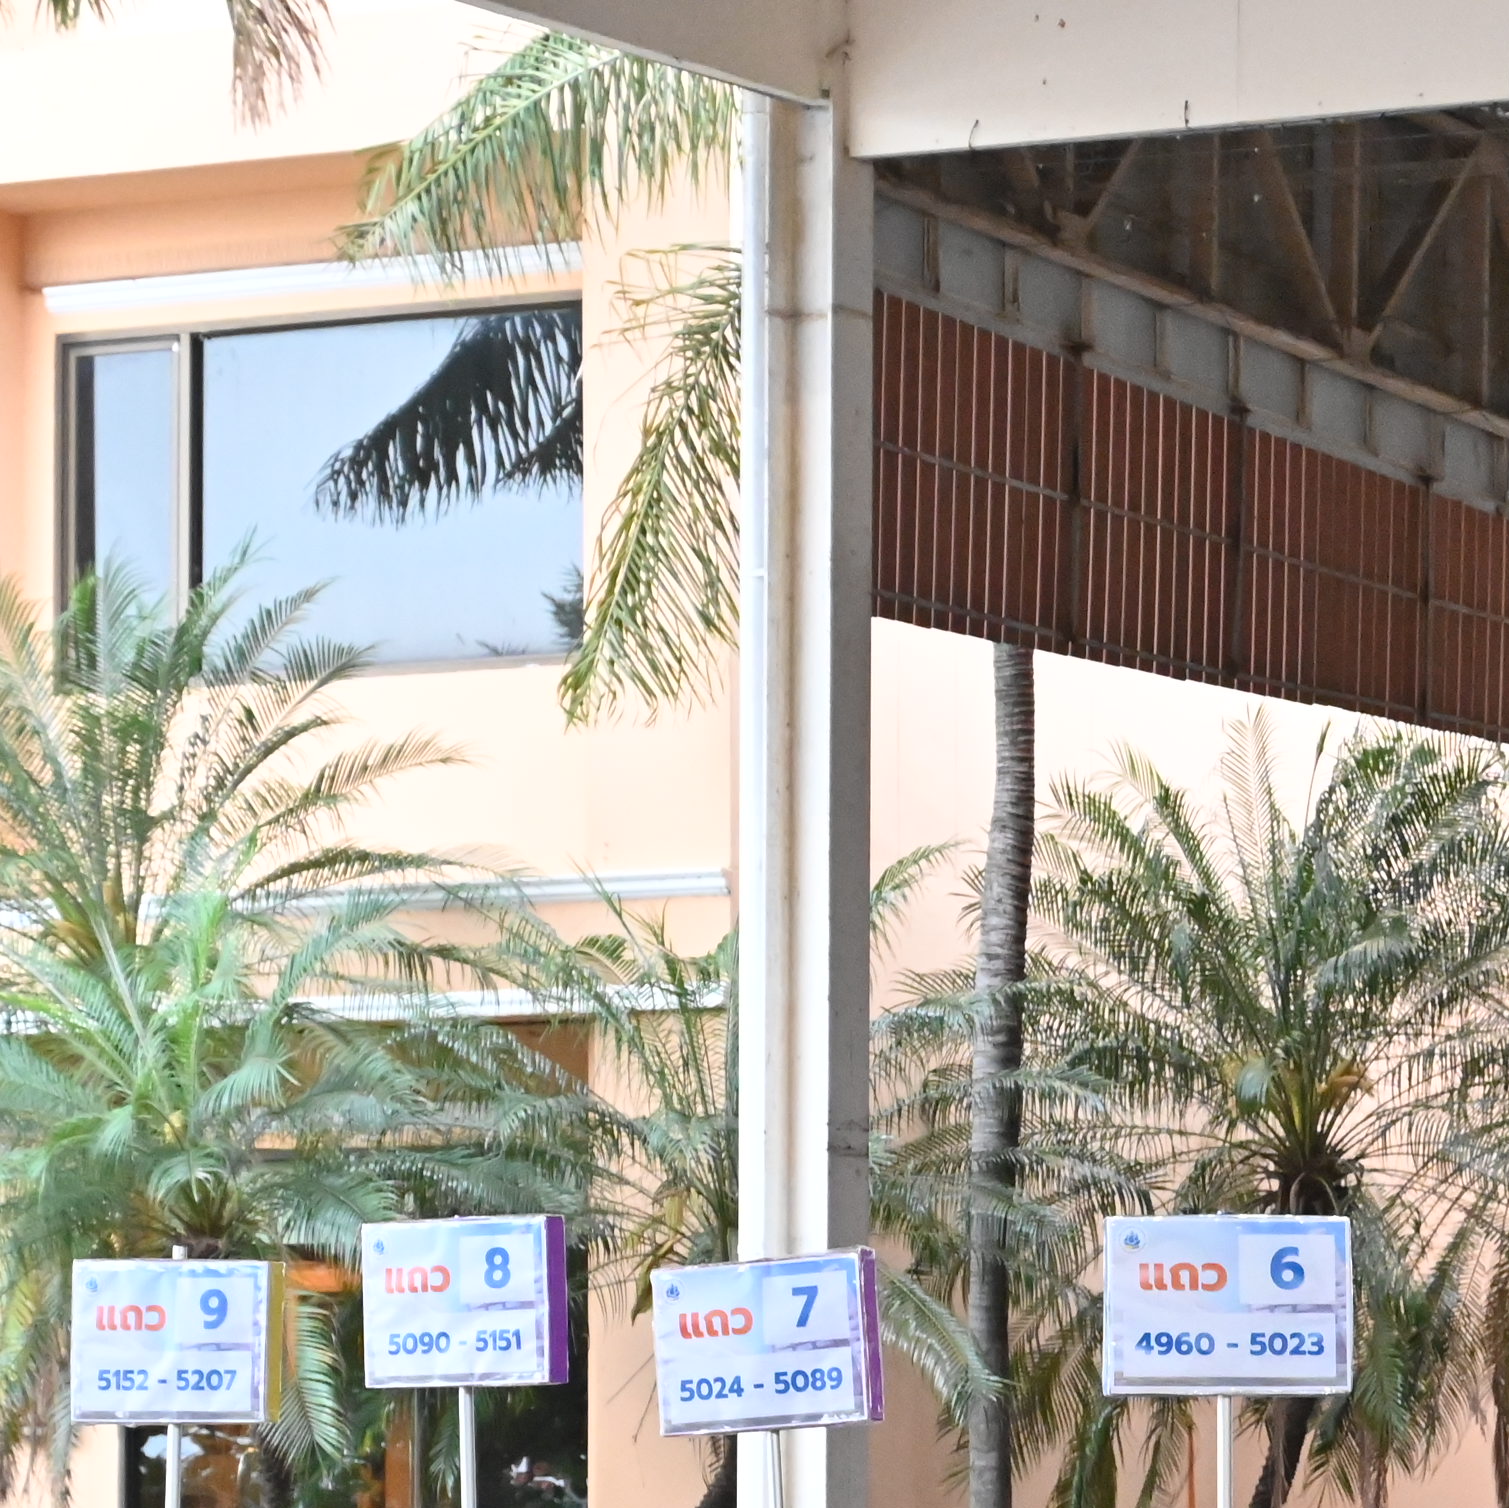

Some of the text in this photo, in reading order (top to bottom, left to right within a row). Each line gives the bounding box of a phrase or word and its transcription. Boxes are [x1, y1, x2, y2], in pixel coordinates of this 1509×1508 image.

[385, 1247, 512, 1294] แถว 8
[1139, 1246, 1307, 1291] แถว 6
[95, 1288, 229, 1332] แถว 9
[679, 1285, 820, 1340] แถว 7
[387, 1331, 451, 1356] 5090
[475, 1328, 522, 1353] 5151
[1134, 1331, 1216, 1357] 4960
[1248, 1331, 1327, 1358] 5023
[97, 1369, 149, 1392] 5152
[175, 1368, 238, 1393] 5207
[679, 1375, 745, 1403] 5024
[773, 1367, 844, 1397] 5089
